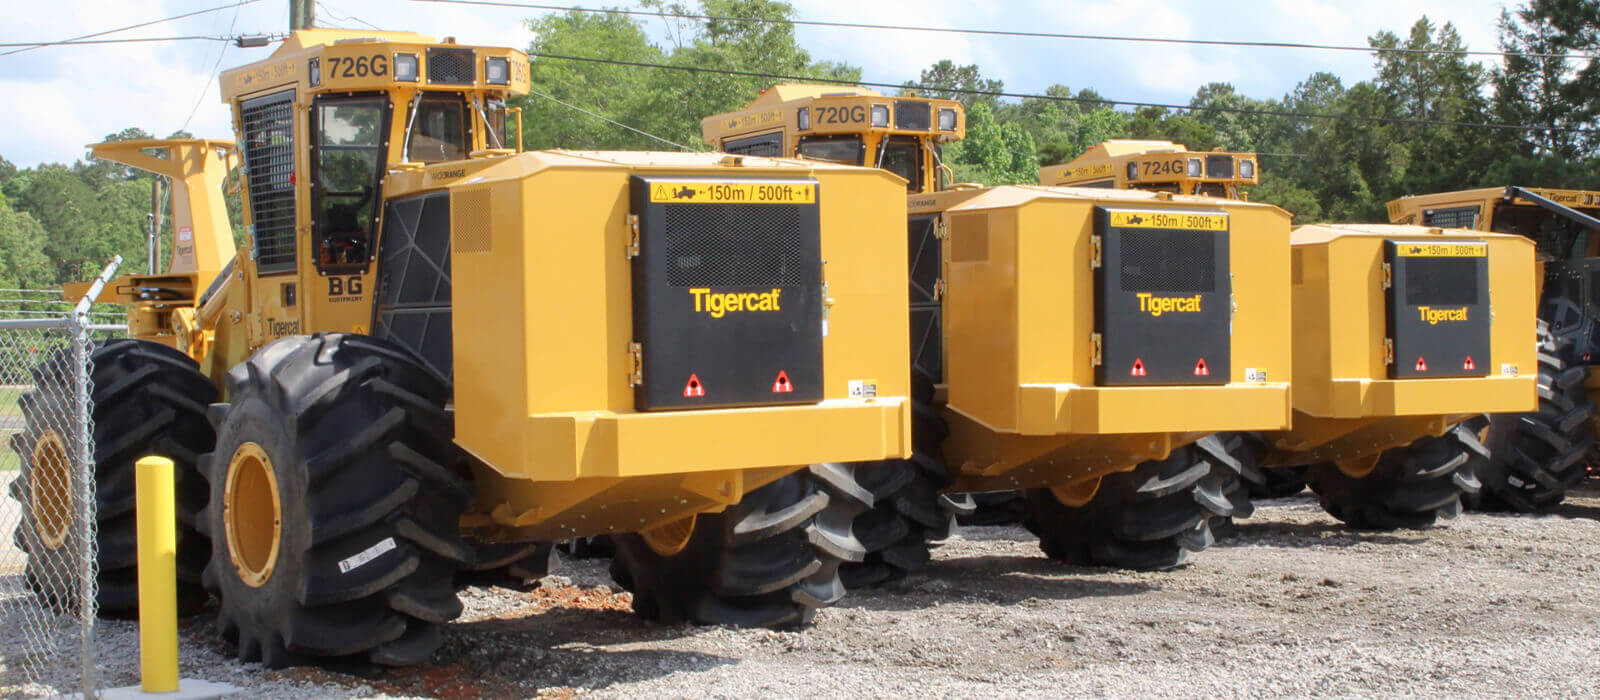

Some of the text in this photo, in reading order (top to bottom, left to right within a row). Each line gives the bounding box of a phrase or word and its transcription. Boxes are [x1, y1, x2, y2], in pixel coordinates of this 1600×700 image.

[327, 54, 388, 78] 726G
[815, 105, 866, 124] 720G
[1142, 160, 1184, 175] 724G
[707, 185, 794, 201] 150m / 500ft
[1549, 192, 1577, 204] Tigercat
[1151, 215, 1178, 227] 150m
[1187, 217, 1212, 228] 500ft
[1428, 245, 1449, 255] 150m
[1455, 246, 1475, 255] 500ft
[689, 288, 782, 319] Tigercat
[1136, 292, 1202, 317] Tigercat
[1418, 306, 1468, 325] Tigercat
